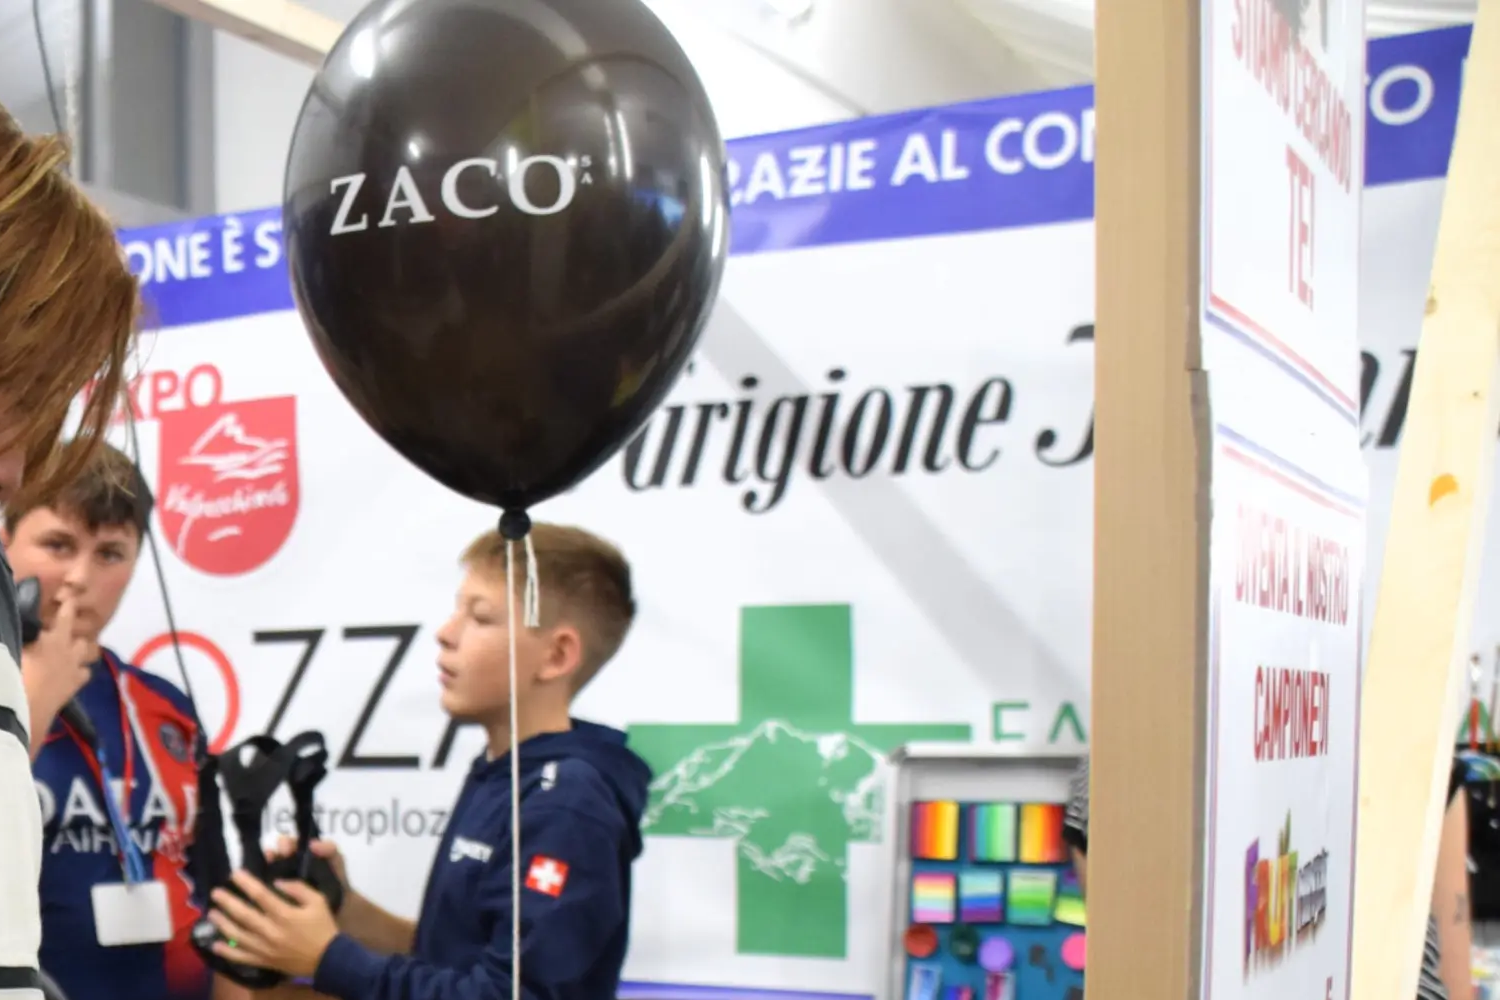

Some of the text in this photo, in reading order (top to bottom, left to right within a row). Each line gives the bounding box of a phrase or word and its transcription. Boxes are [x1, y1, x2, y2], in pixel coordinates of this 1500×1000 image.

[890, 130, 969, 187] AL
[329, 154, 576, 236] ZACO
[221, 216, 245, 274] È
